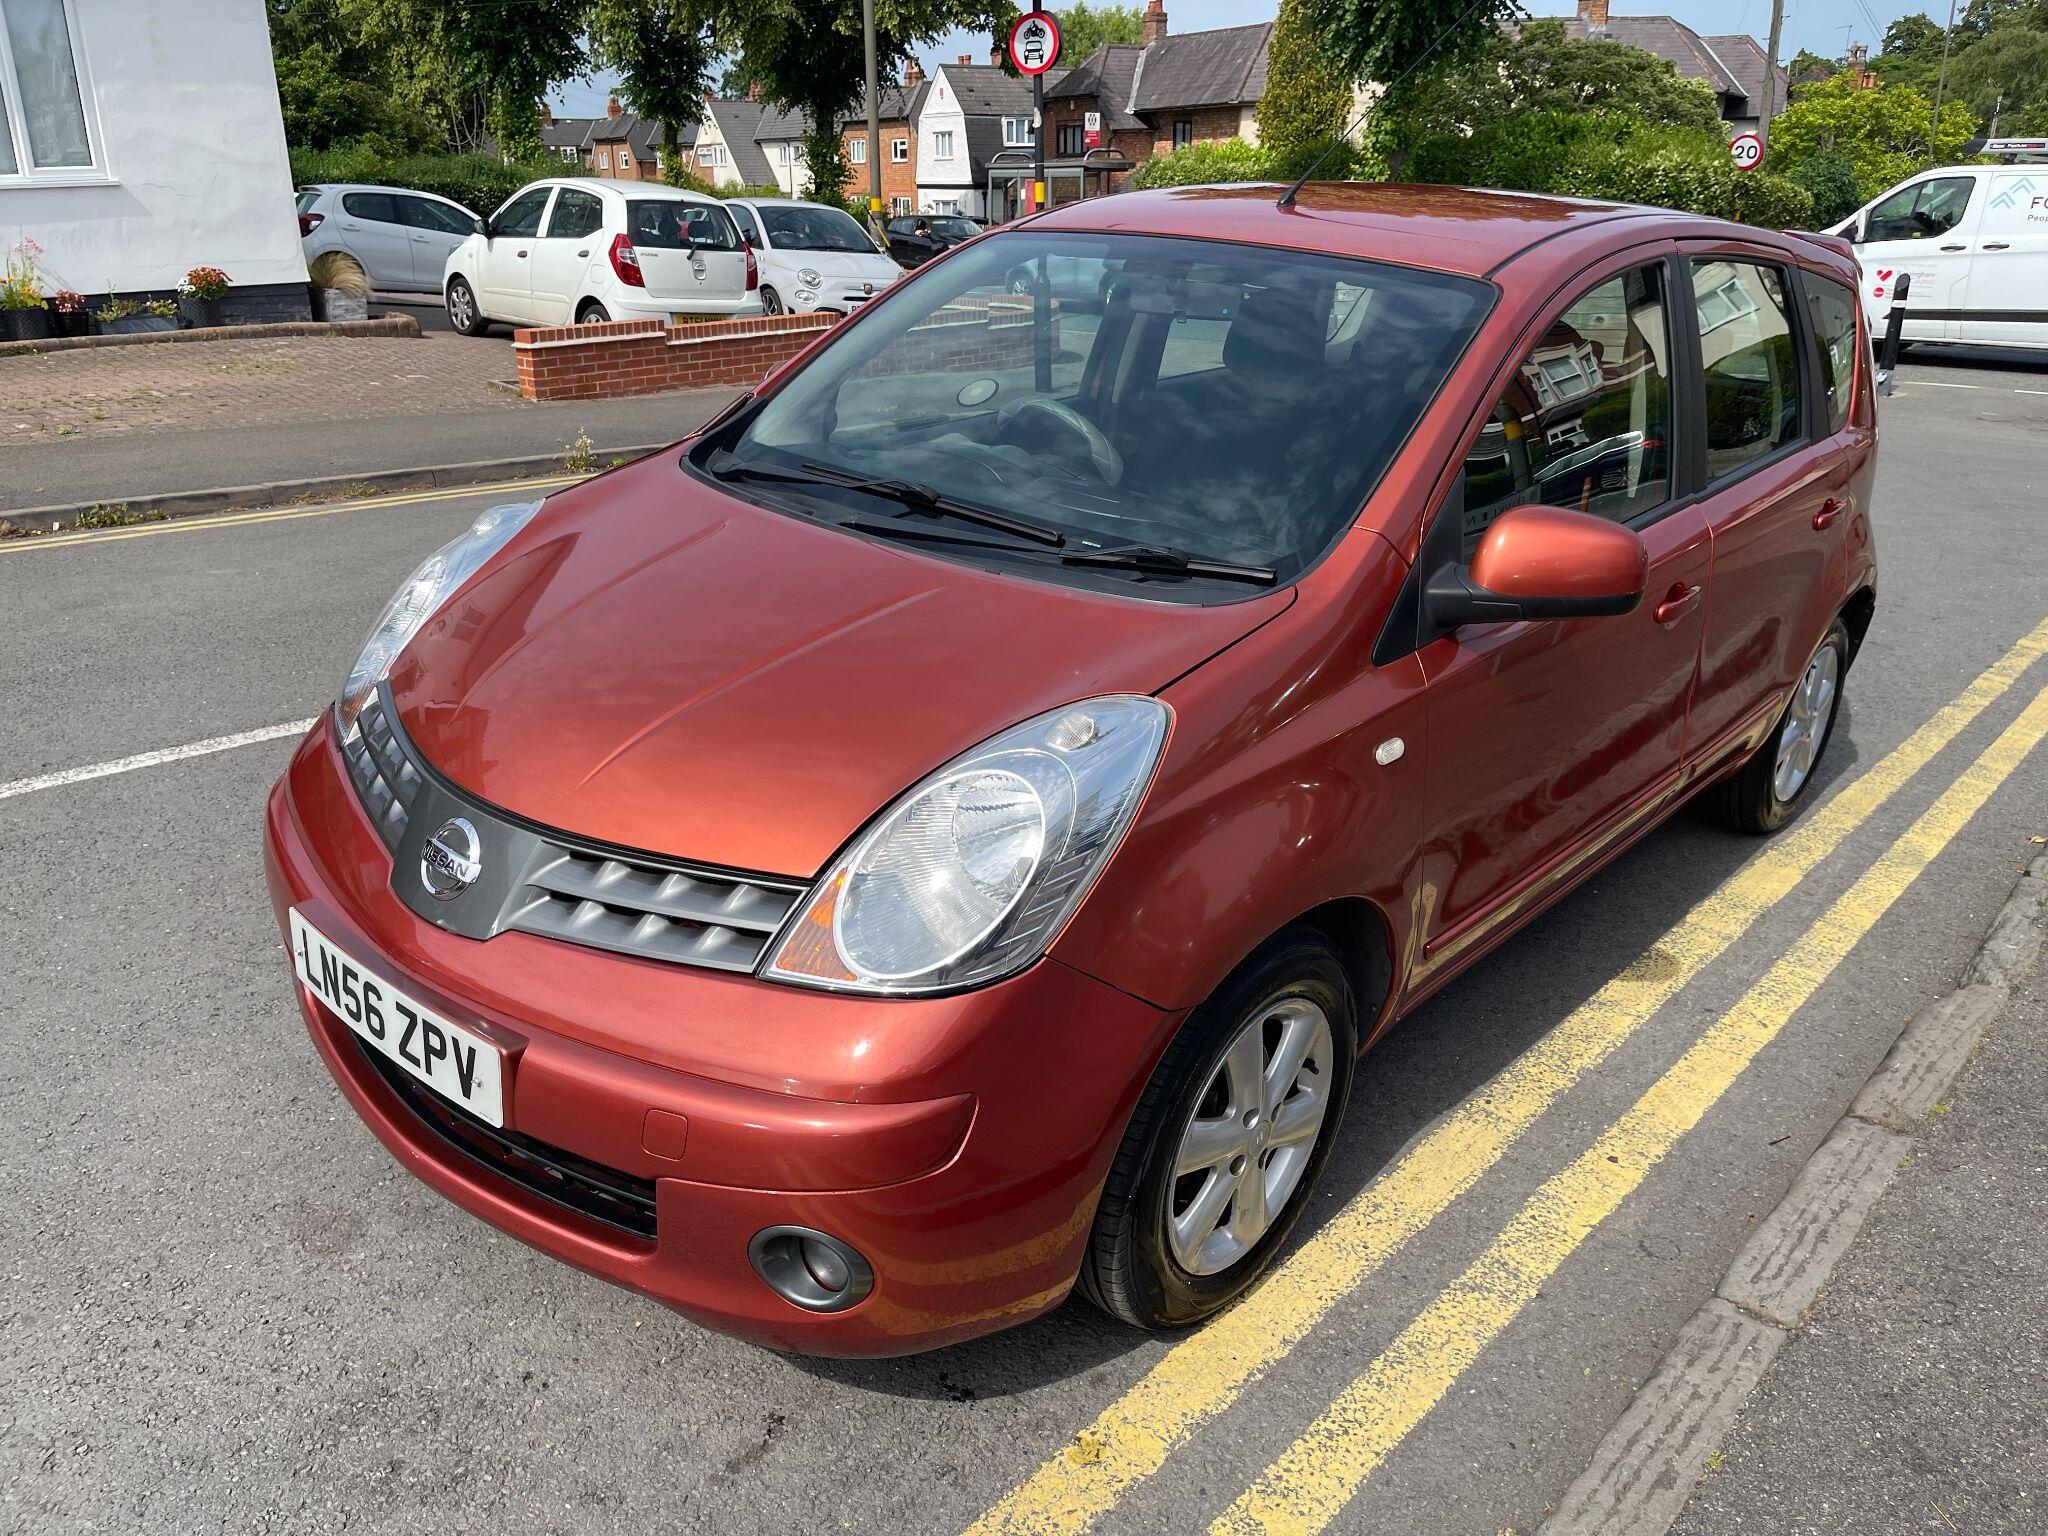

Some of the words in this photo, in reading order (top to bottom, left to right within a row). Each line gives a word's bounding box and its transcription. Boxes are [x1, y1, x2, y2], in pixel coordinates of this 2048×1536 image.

[1734, 145, 1758, 159] 20
[423, 843, 470, 879] NISSAN
[301, 928, 386, 1041] LN56
[395, 1000, 477, 1101] ZPV
